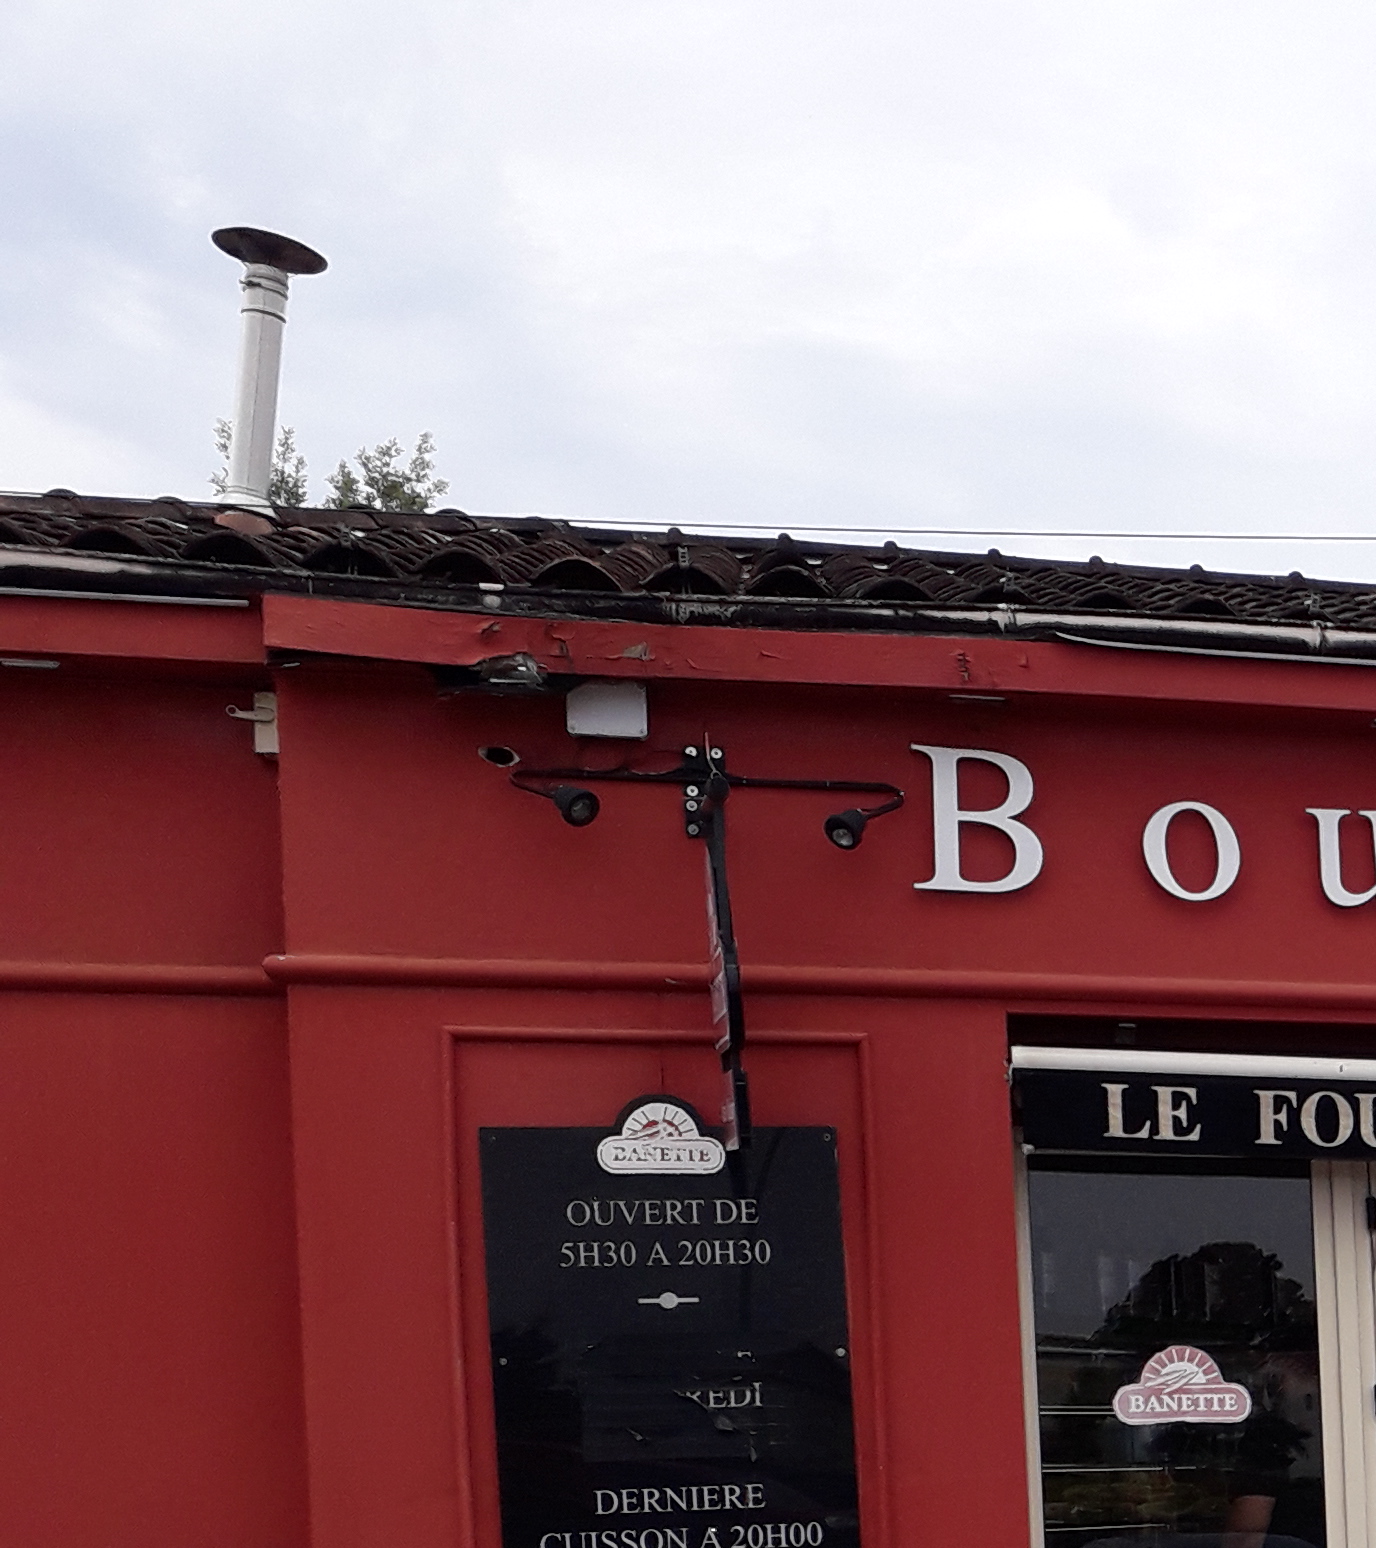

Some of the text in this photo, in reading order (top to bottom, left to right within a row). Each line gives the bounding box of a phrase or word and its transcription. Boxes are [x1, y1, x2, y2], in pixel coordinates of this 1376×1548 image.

[1101, 1082, 1202, 1142] LE
[612, 1145, 711, 1163] BANETTE
[566, 1199, 759, 1226] OUVERT DE
[559, 1239, 771, 1267] 5H30 A 20H30
[1128, 1394, 1239, 1413] BANETTE
[593, 1484, 766, 1515] DERNIERE
[730, 1521, 823, 1548] 20H00
